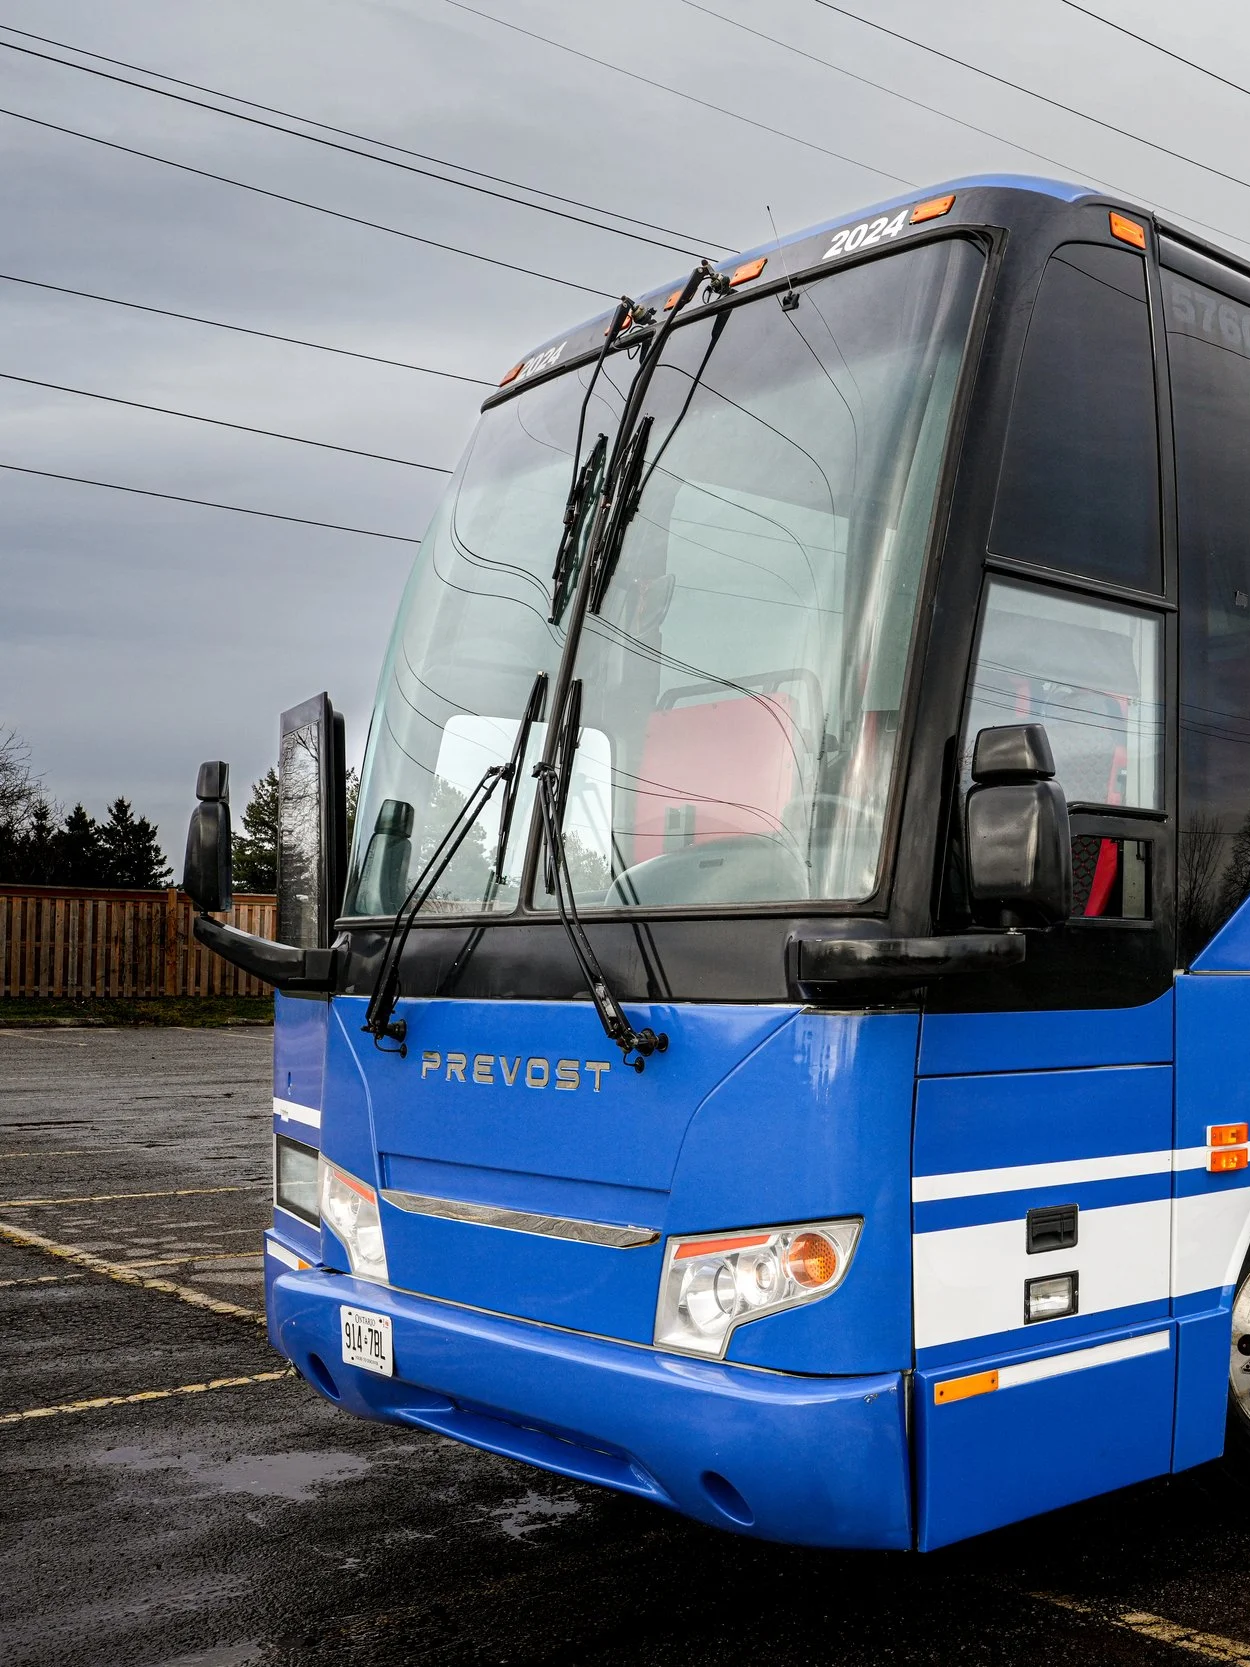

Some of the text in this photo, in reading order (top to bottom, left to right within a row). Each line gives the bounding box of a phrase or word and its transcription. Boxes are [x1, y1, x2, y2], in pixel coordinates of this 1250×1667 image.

[822, 209, 909, 260] 2024
[514, 341, 568, 382] 2024
[421, 1051, 612, 1093] PREVOST
